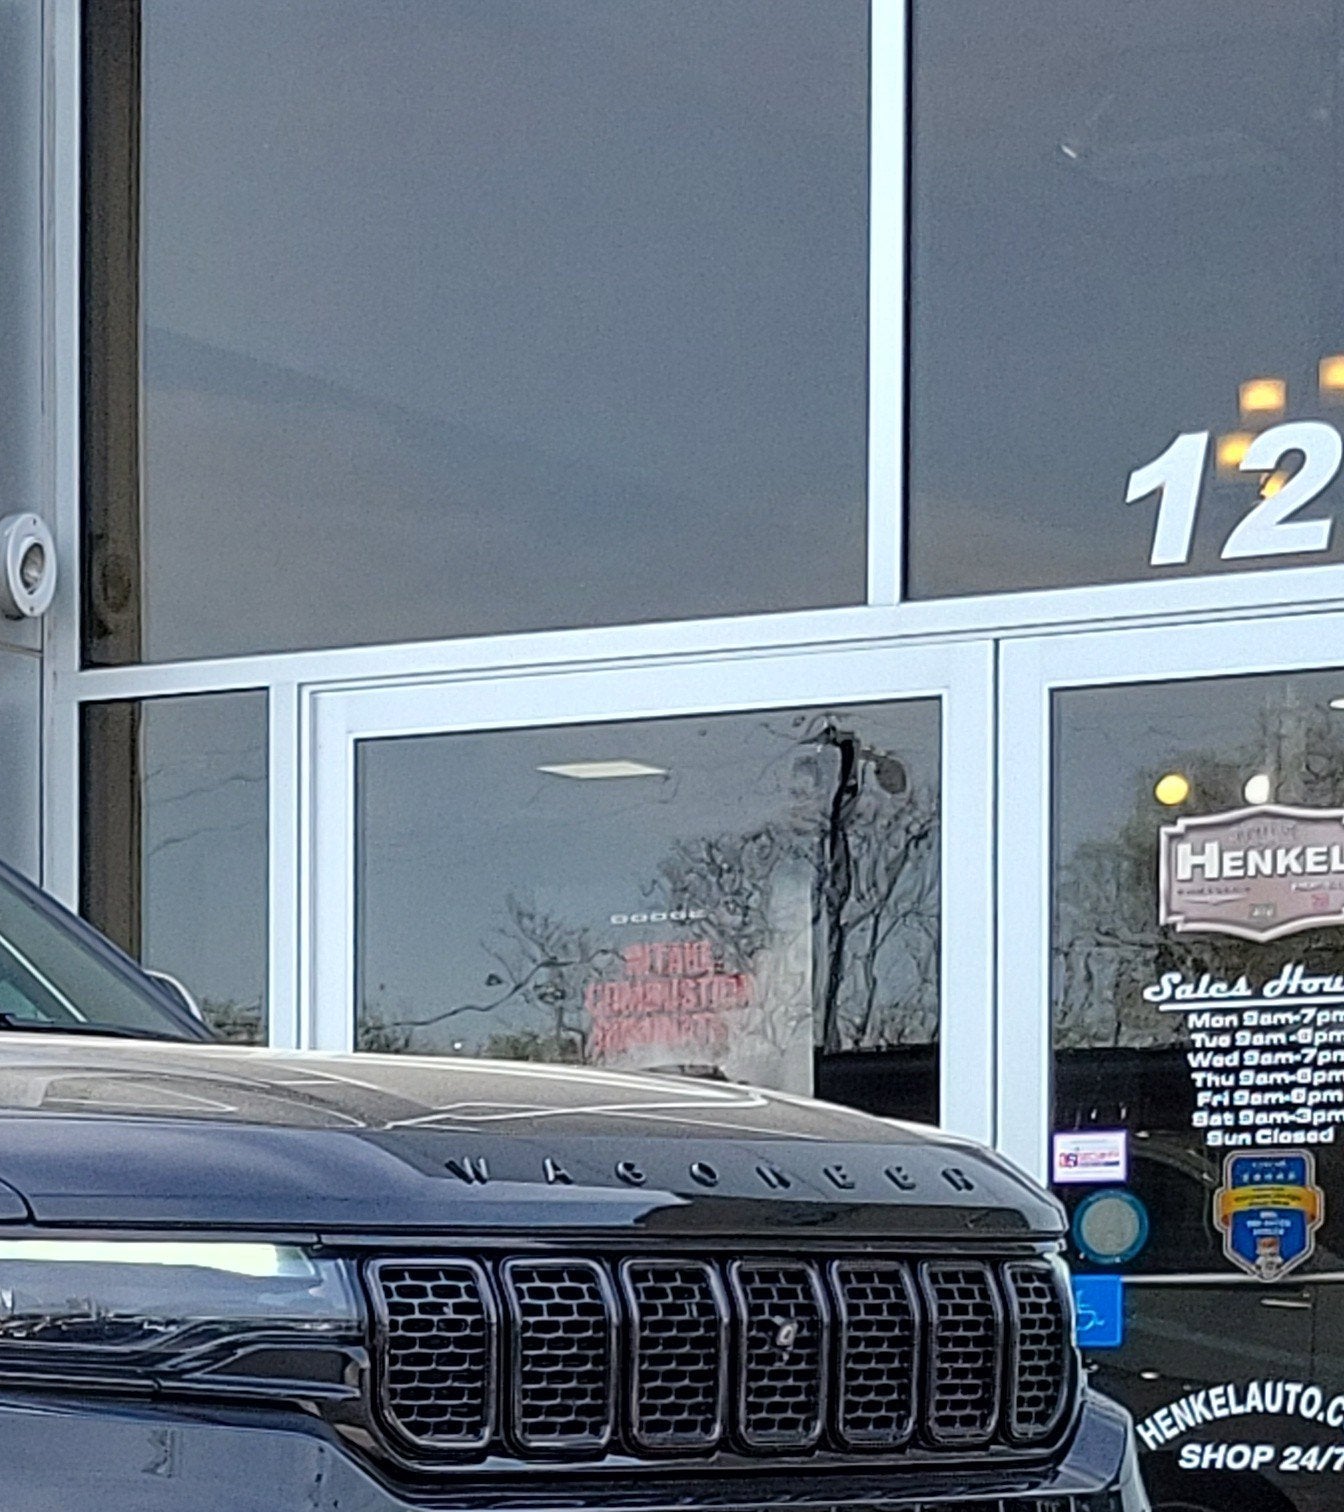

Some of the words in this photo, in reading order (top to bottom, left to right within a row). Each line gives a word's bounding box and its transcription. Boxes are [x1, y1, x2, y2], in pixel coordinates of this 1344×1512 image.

[1125, 421, 1343, 565] 12
[1143, 972, 1252, 1001] Sales
[1188, 1011, 1238, 1029] Mon
[1191, 1032, 1231, 1048] Tue
[1187, 1050, 1240, 1068] Wed
[1191, 1071, 1235, 1088] Thu
[1197, 1090, 1229, 1107] Fri
[1192, 1111, 1234, 1127] Sat
[1206, 1130, 1252, 1146] Sun
[1255, 1126, 1334, 1145] Closed
[445, 1156, 979, 1191] WAGONEER
[1178, 1443, 1275, 1470] SHOP
